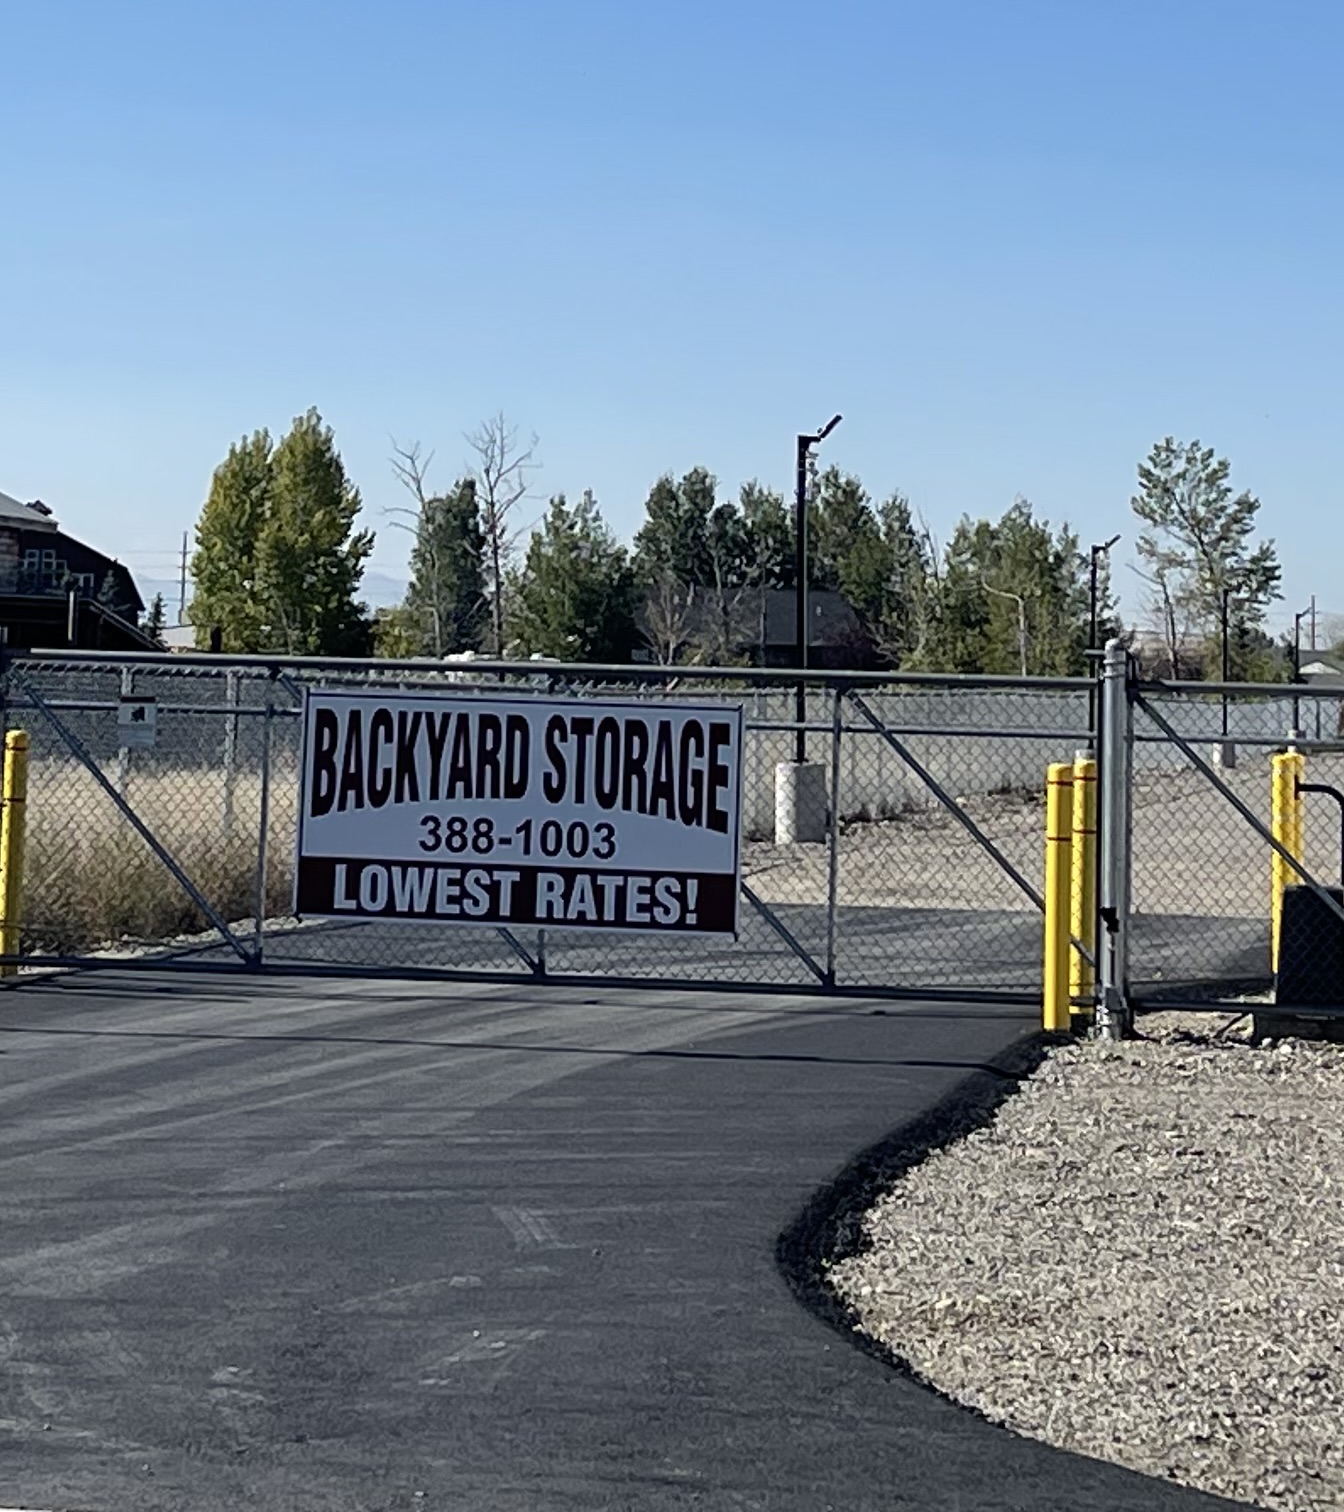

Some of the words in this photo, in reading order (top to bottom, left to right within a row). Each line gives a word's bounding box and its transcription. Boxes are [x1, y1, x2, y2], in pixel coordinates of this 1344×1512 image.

[310, 707, 531, 818] BACKYARD
[542, 712, 731, 835] STORAGE
[418, 814, 617, 860] 388-1003
[333, 863, 521, 918] LOWEST
[535, 872, 699, 926] RATES!
